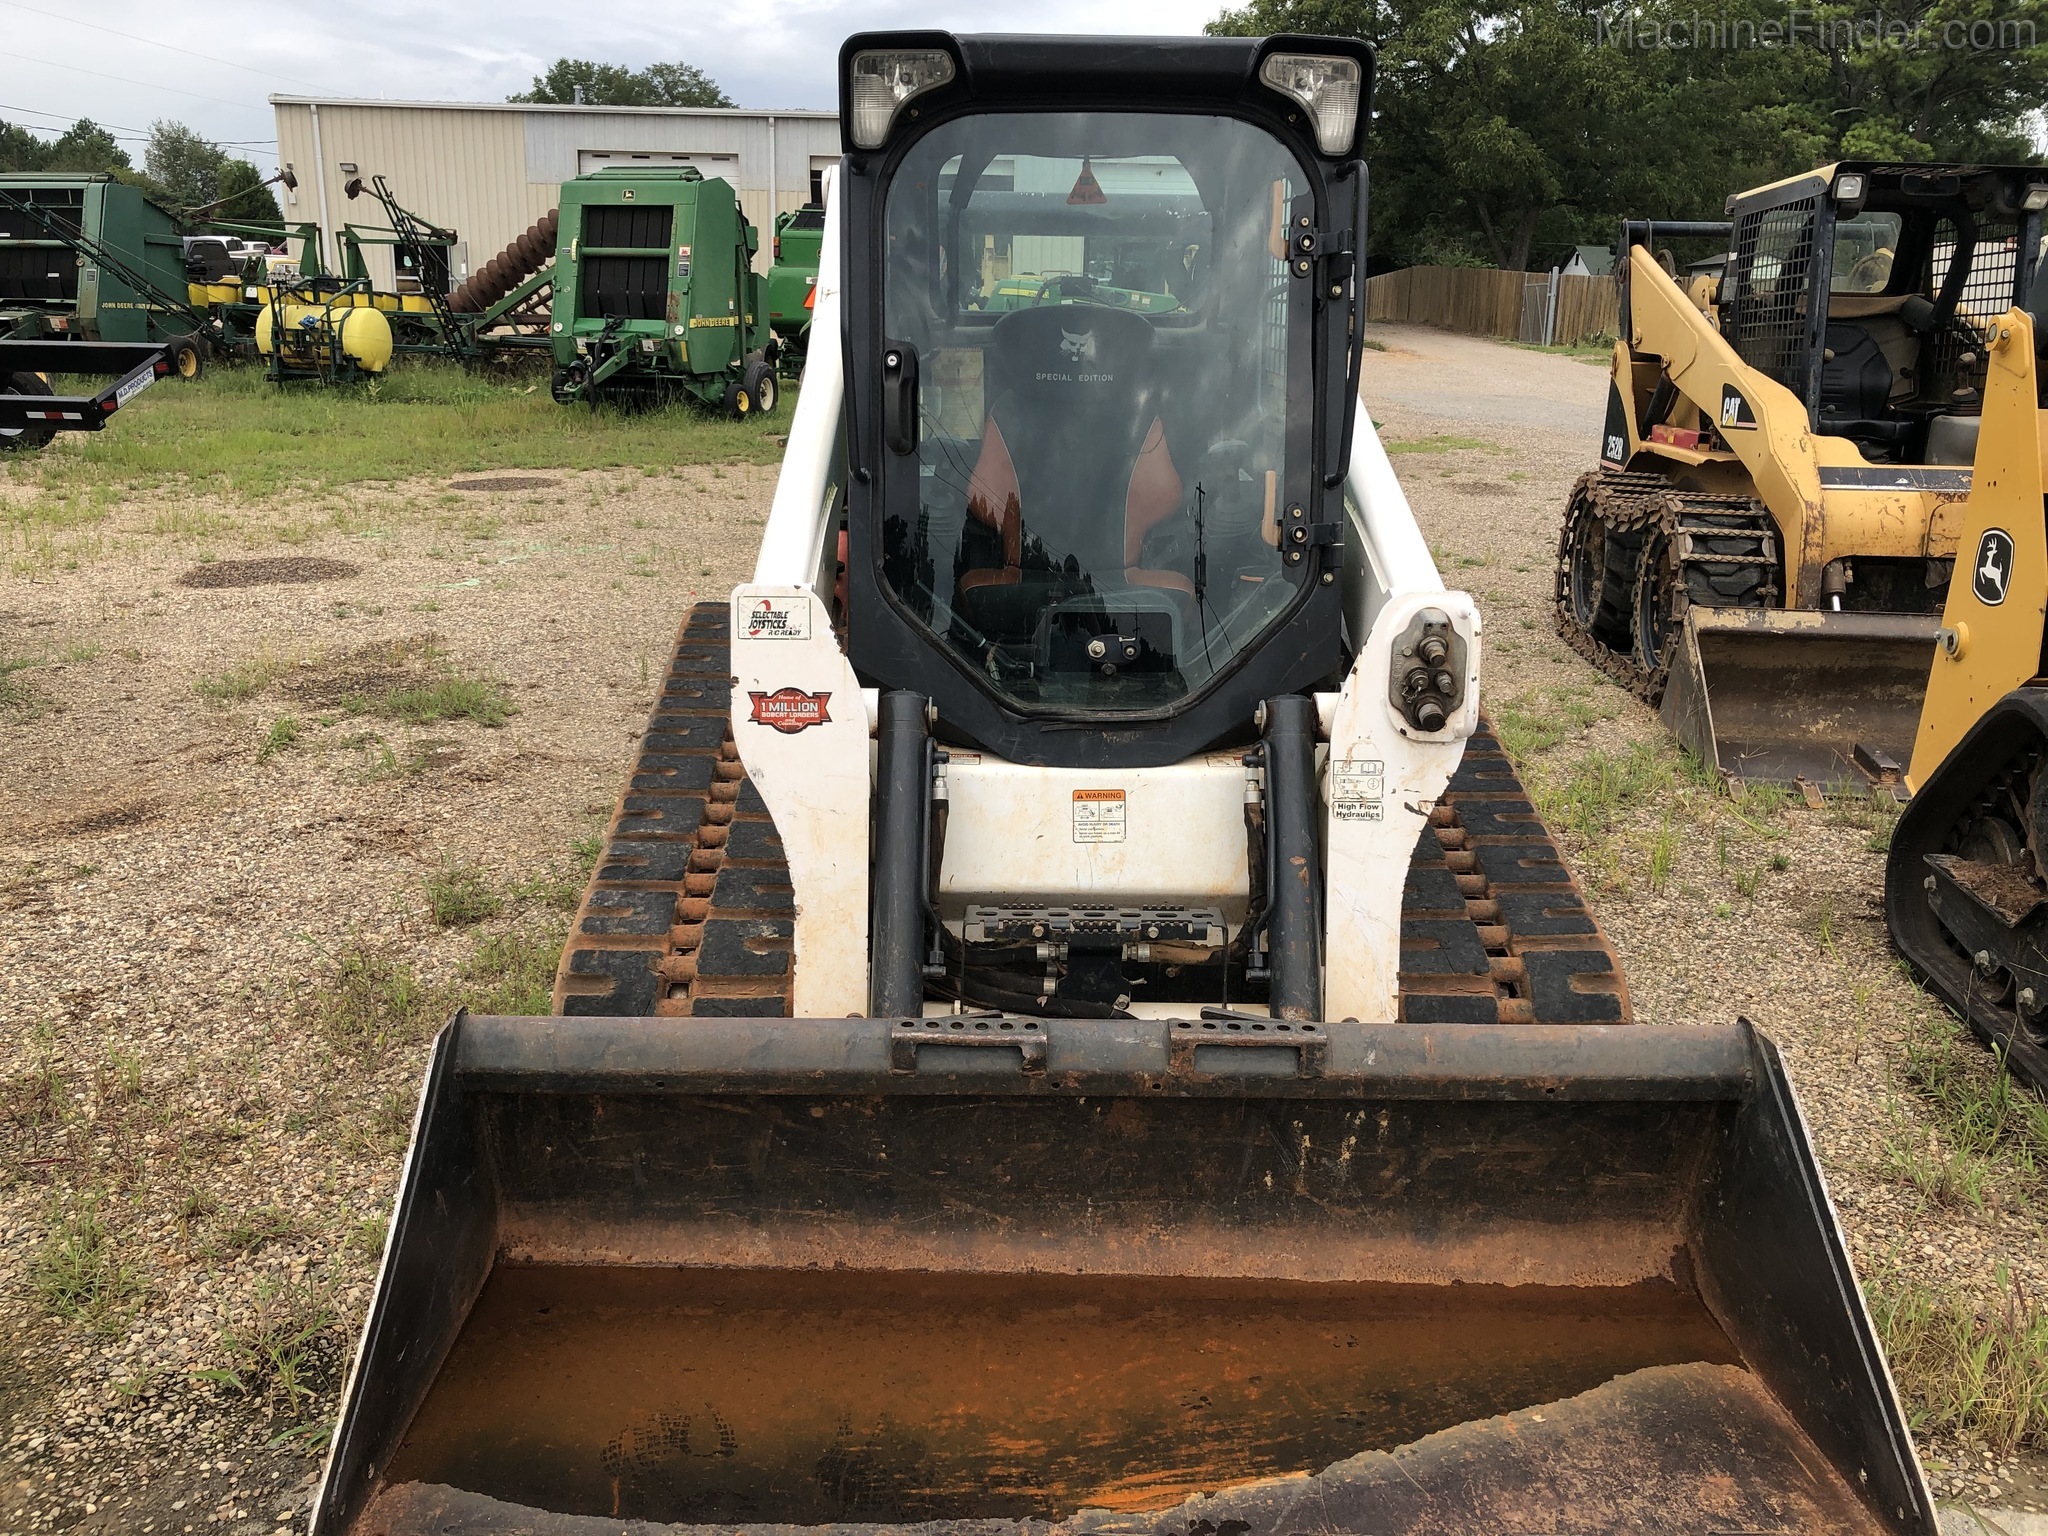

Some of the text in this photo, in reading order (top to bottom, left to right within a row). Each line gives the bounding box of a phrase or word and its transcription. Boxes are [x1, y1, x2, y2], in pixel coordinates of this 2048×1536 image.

[694, 317, 730, 327] JOHN DEERE
[1035, 372, 1114, 382] SPECIAL EDITION
[1722, 396, 1741, 426] CAT
[1606, 434, 1624, 461] 252B
[751, 611, 789, 619] SELECTABLE
[748, 619, 787, 629] JOYSTICKS
[761, 702, 819, 712] 1 MILLION
[1338, 803, 1356, 811] High
